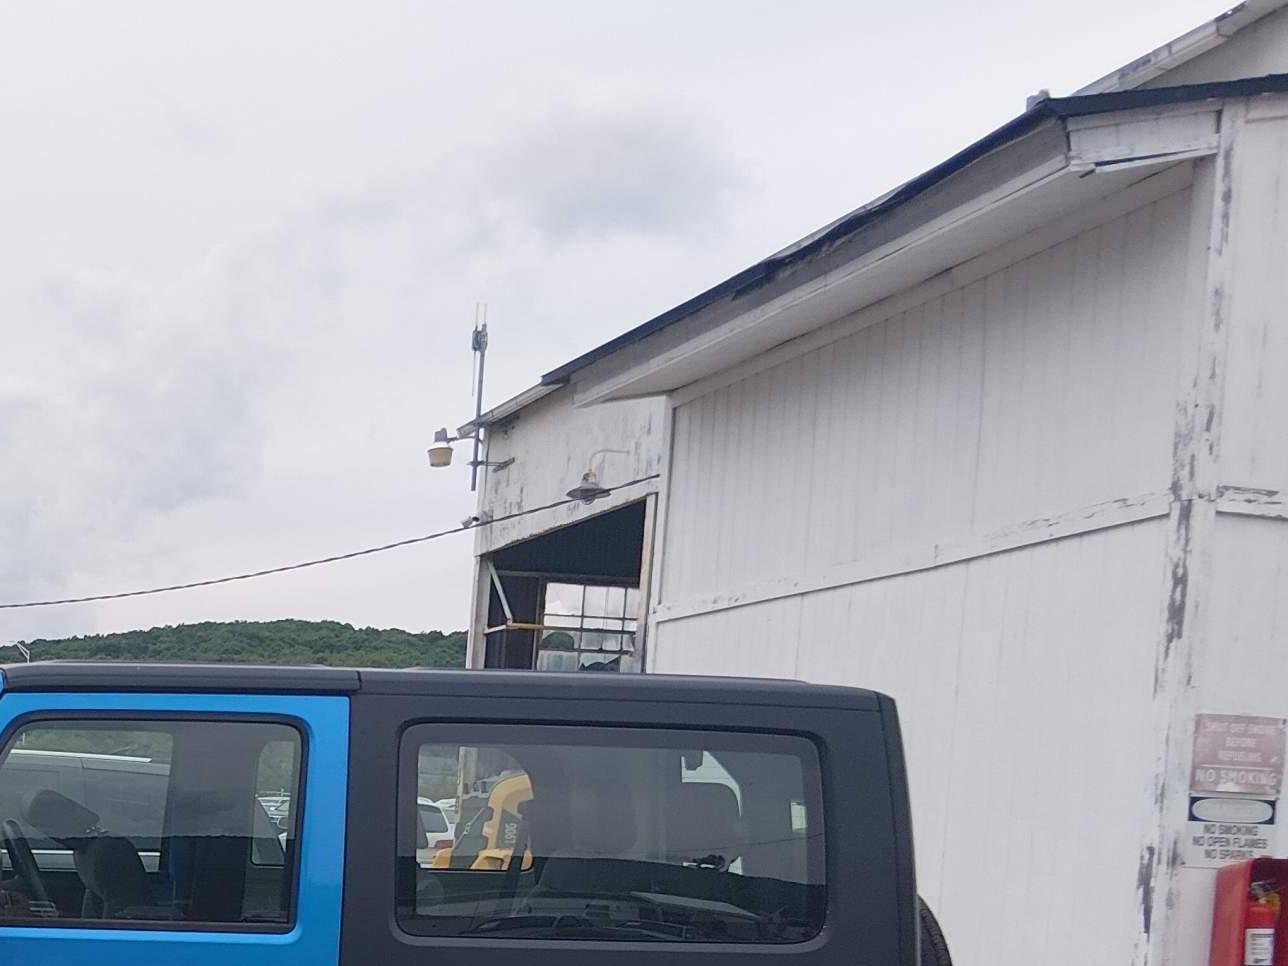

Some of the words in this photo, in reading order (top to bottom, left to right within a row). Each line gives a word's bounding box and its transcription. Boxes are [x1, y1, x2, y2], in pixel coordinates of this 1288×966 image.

[1195, 769, 1216, 782] NO
[1219, 769, 1278, 786] SMOKING
[1203, 824, 1217, 834] NO
[1218, 824, 1258, 836] SMOKING
[1192, 836, 1206, 846] NO
[1207, 837, 1231, 847] OPEN
[1232, 837, 1269, 849] FLAMES
[1204, 849, 1217, 859] NO
